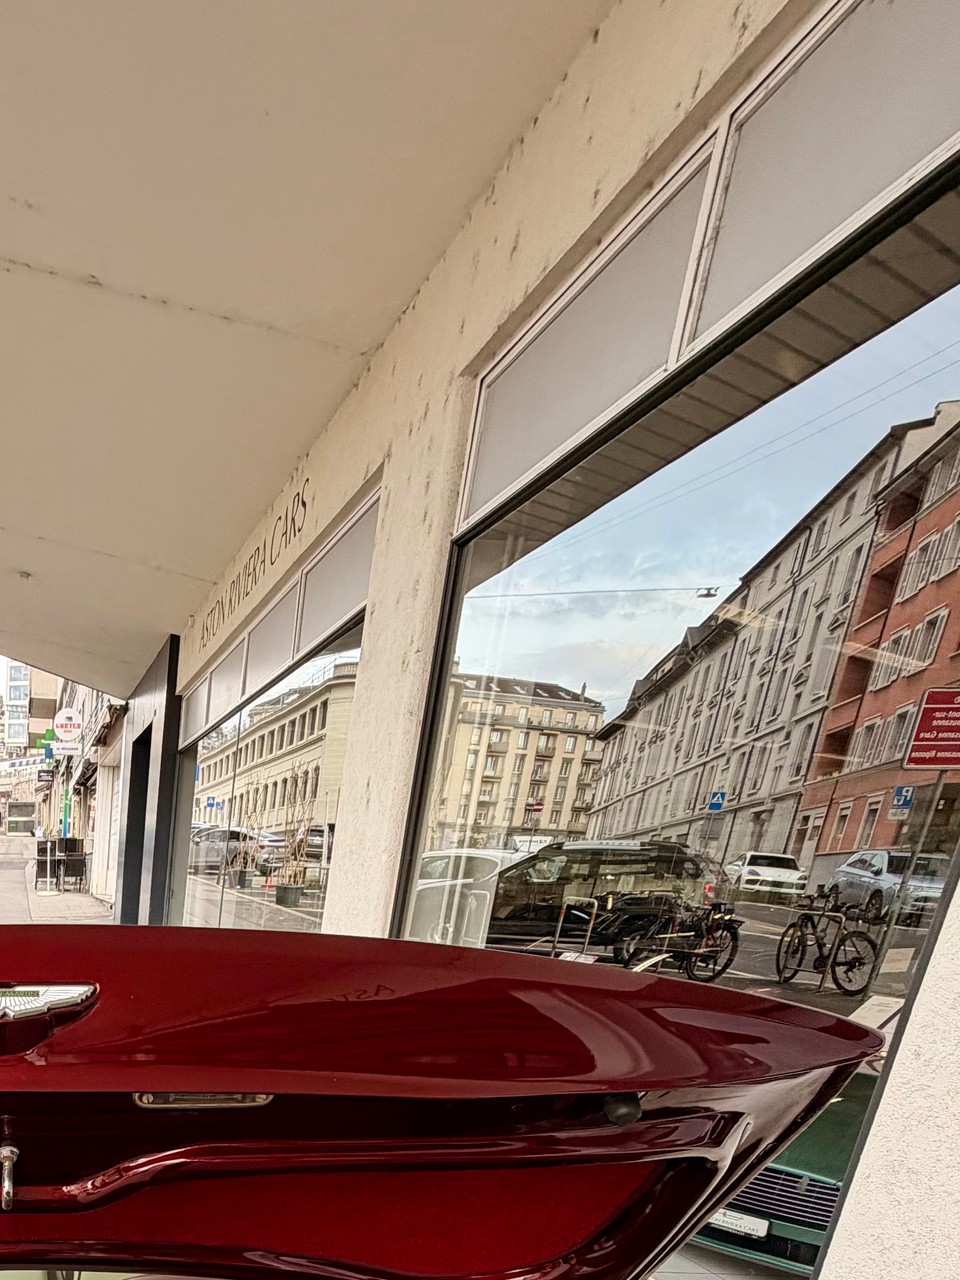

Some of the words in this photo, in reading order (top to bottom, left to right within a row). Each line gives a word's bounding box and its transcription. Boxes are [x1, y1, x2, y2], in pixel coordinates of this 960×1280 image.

[199, 589, 228, 652] ASTON
[227, 537, 267, 619] RIVIERA
[270, 477, 310, 567] CARS
[743, 1225, 759, 1233] CARS
